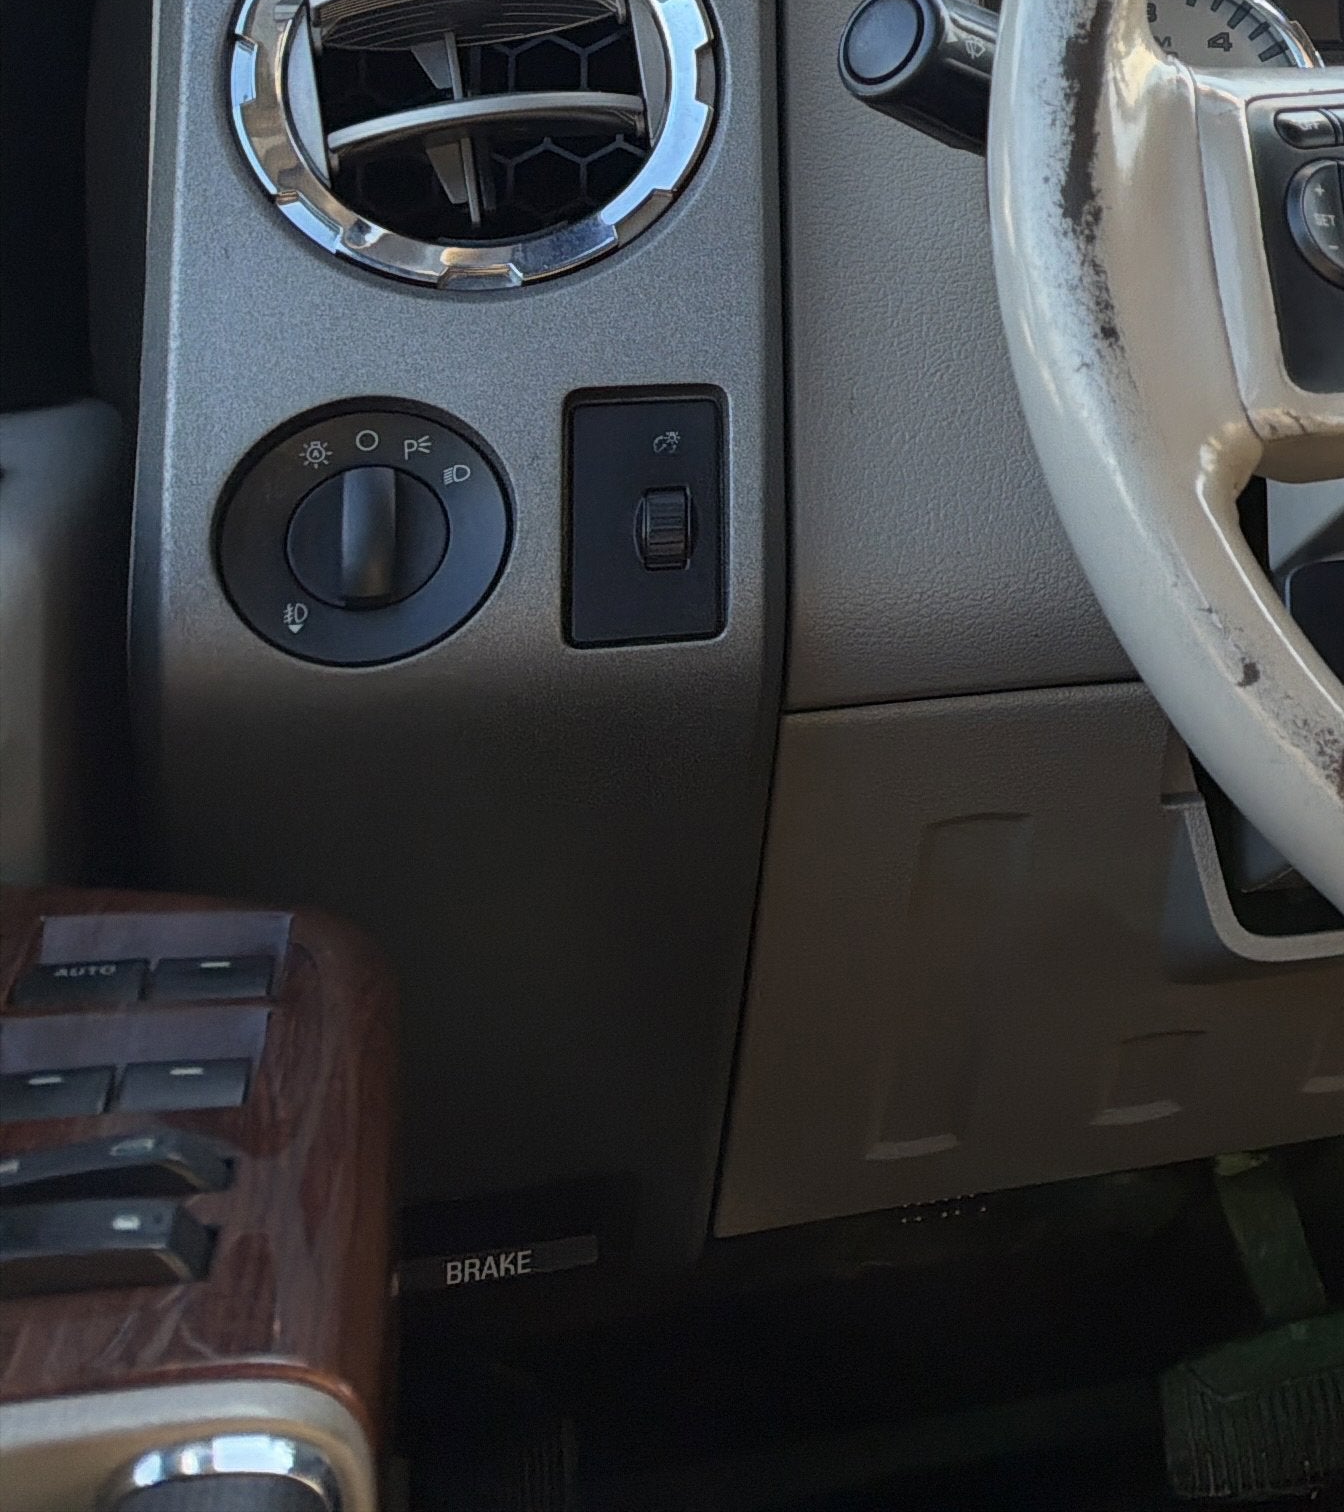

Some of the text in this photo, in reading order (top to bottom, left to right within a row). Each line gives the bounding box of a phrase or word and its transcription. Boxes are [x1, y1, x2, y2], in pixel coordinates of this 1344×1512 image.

[1207, 31, 1233, 52] 4
[1313, 212, 1337, 227] SET
[54, 964, 117, 977] AUTO
[446, 1250, 532, 1284] BRAKE
